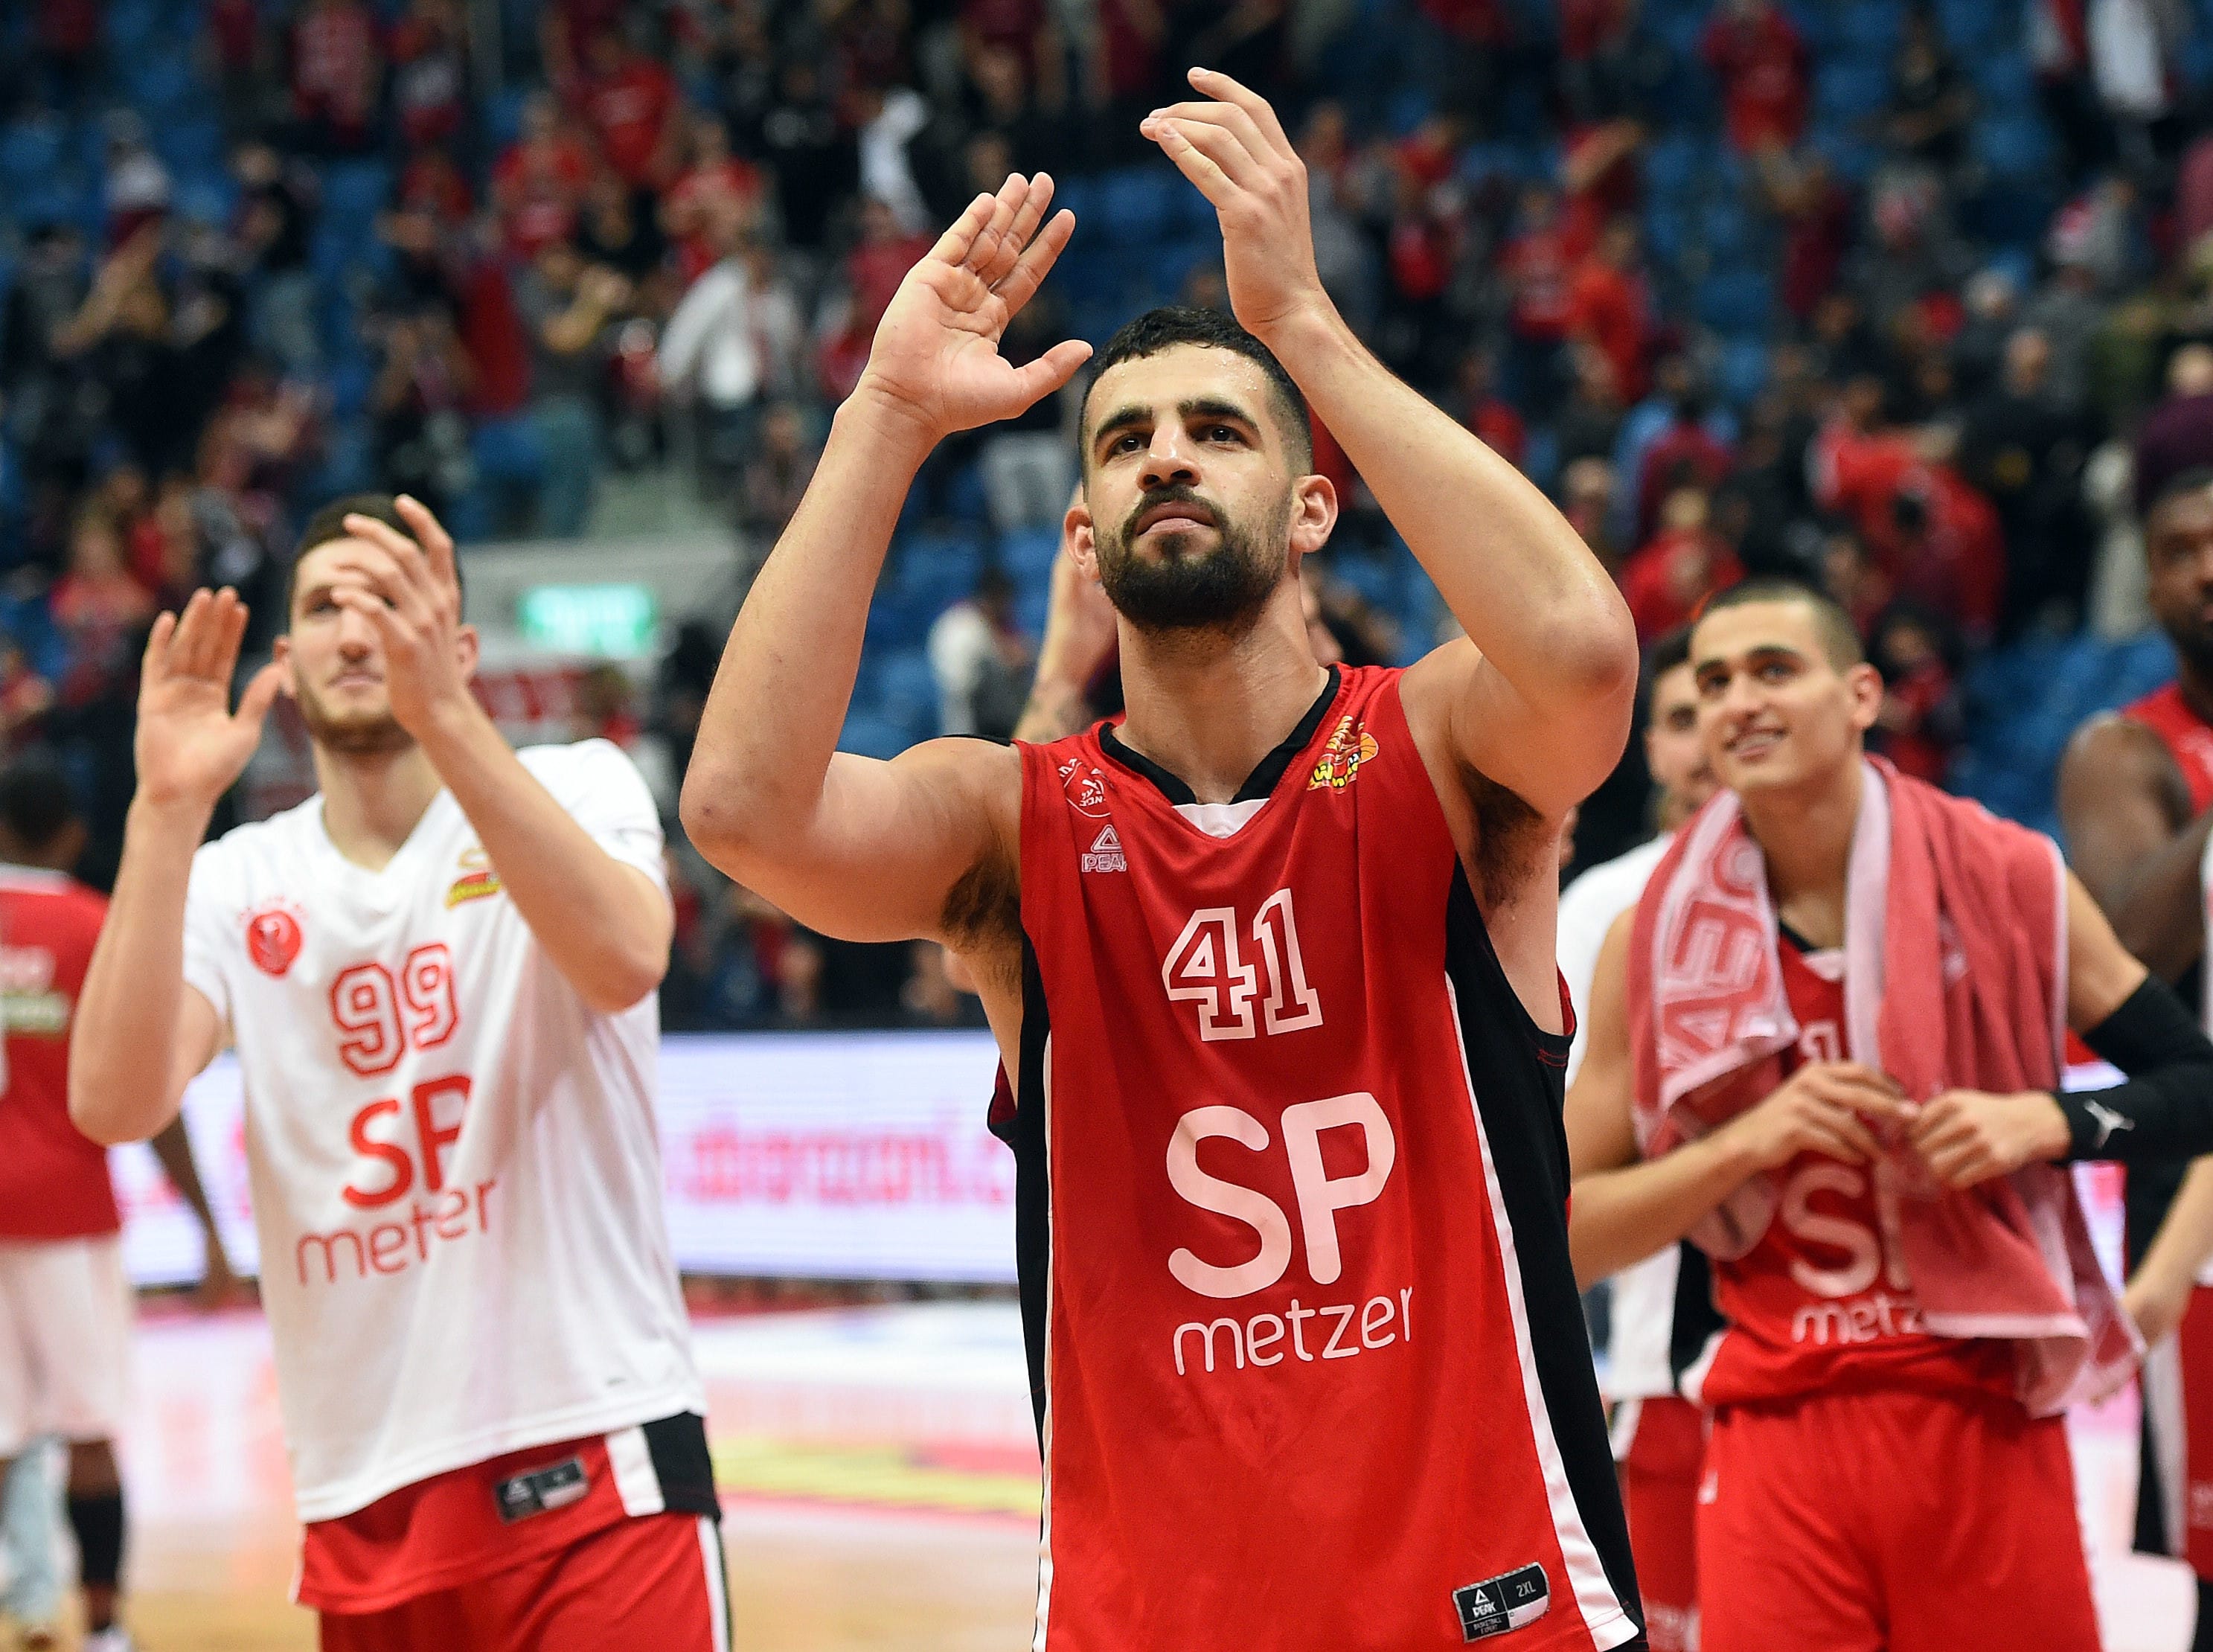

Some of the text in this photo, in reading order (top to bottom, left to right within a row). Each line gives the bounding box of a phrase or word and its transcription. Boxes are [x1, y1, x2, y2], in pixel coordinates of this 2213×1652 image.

[330, 943, 459, 1077] 99
[1161, 888, 1324, 1041] 41
[342, 1074, 473, 1209] SP
[1166, 1092, 1396, 1299] SP
[1173, 1286, 1413, 1375] metzer
[1792, 1293, 1927, 1345] metz
[1472, 1601, 1497, 1618] PEAK
[1516, 1581, 1537, 1598] 2XL
